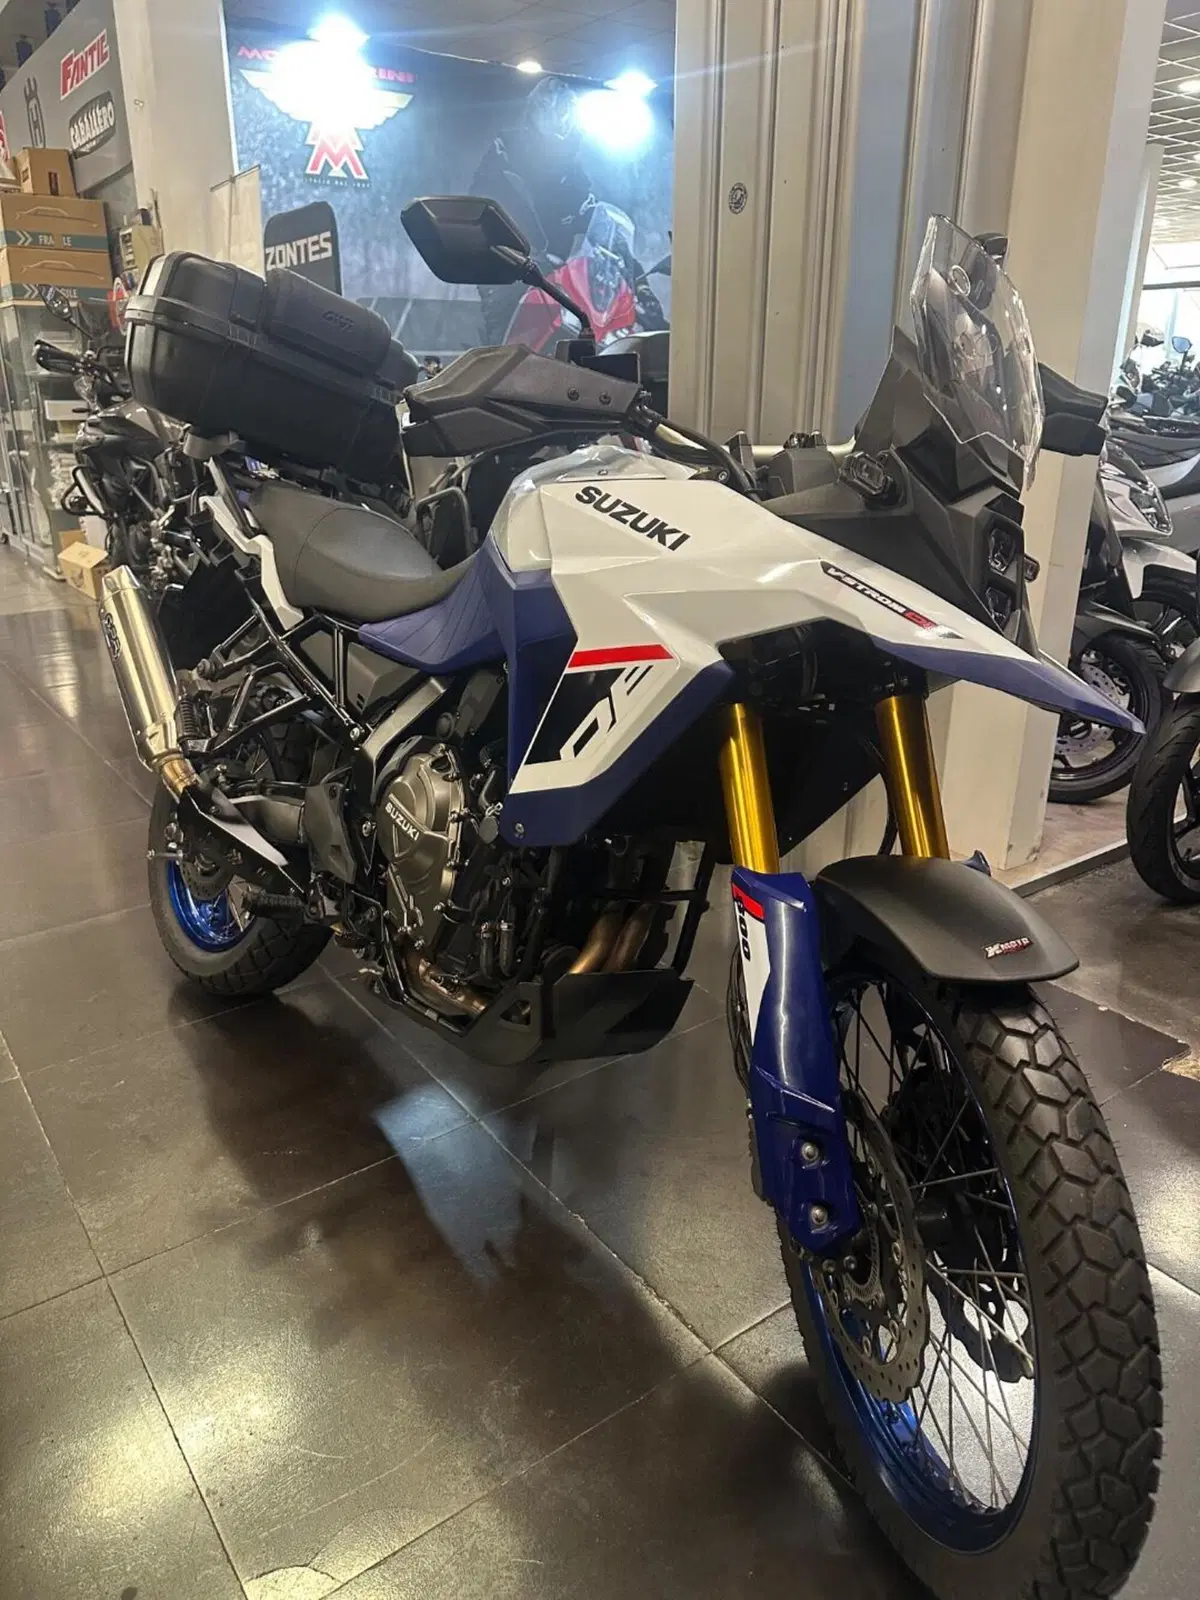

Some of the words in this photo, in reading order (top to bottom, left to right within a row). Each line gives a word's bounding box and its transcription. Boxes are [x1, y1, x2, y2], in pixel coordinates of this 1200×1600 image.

[70, 100, 115, 150] CABALLERO
[38, 234, 73, 248] FRALE
[265, 230, 333, 271] ZONTES
[575, 485, 690, 552] SUZUKI
[385, 802, 420, 841] SUZUKI
[737, 895, 751, 962] 800
